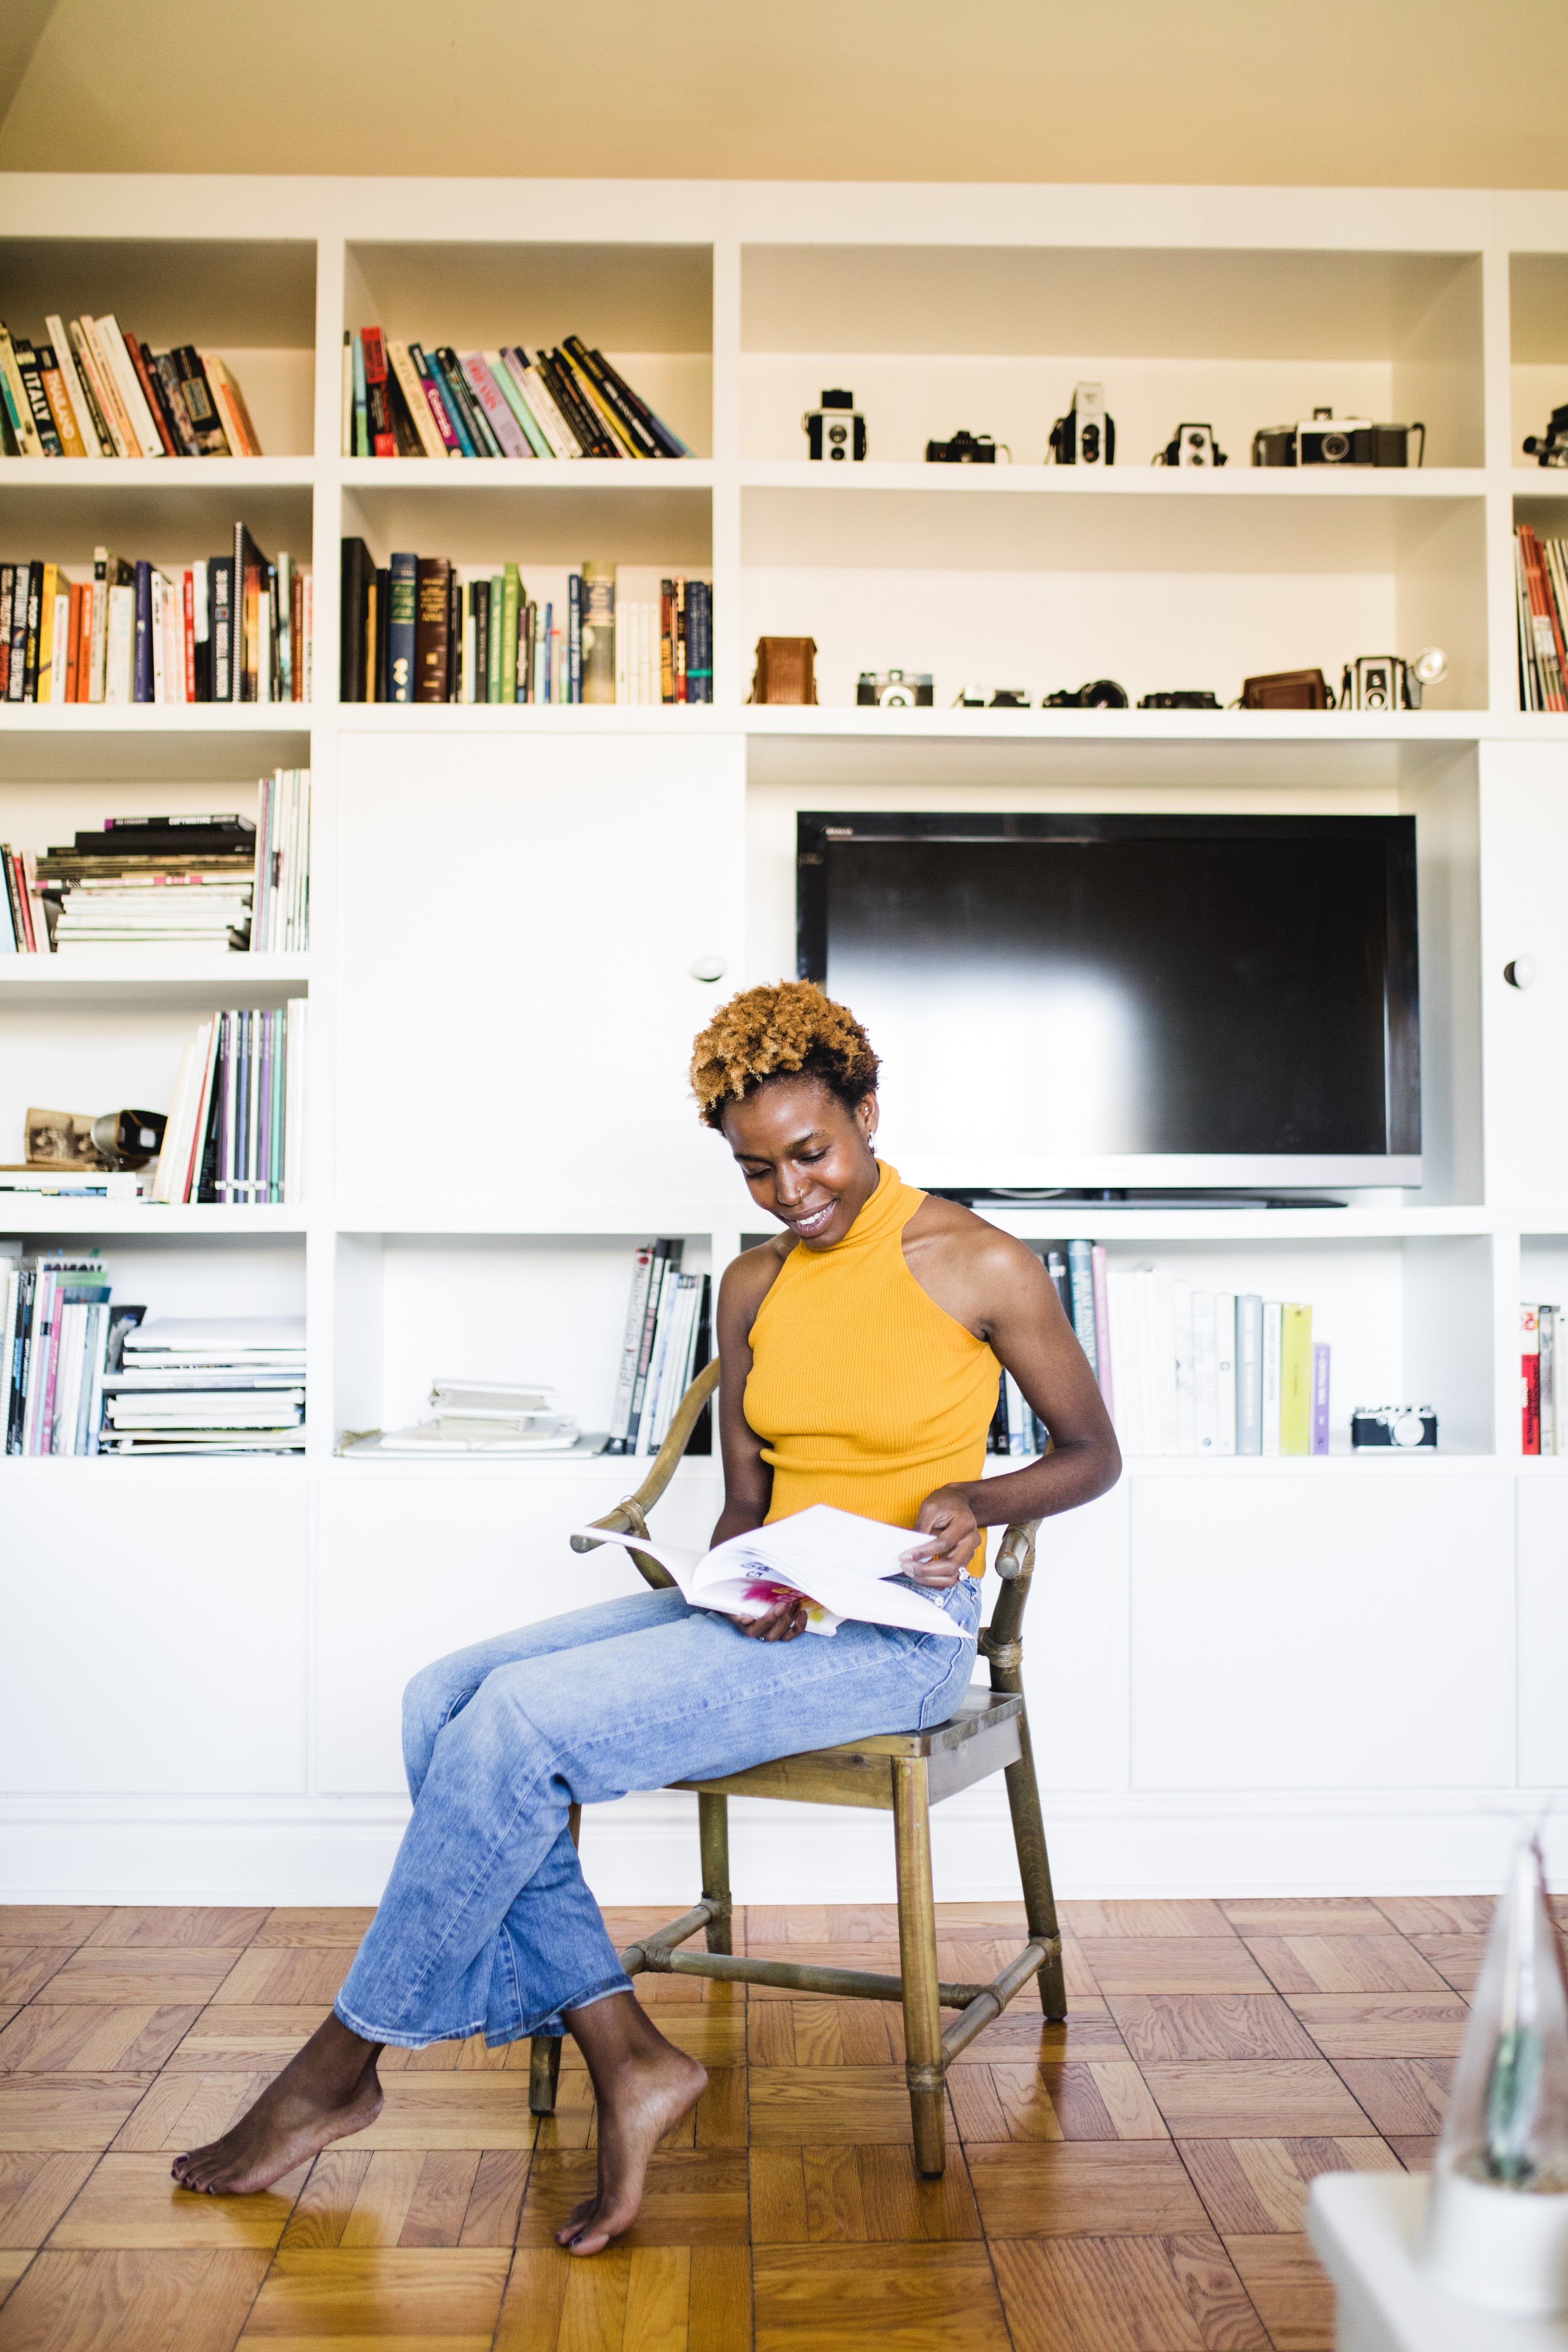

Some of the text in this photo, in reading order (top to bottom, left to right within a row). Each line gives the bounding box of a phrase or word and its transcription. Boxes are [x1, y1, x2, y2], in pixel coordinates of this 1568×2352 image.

[24, 372, 52, 421] ITALY
[45, 371, 76, 440] THAILAND
[427, 388, 452, 439] Colorado
[14, 567, 29, 628] OPPORTUNITY
[168, 817, 211, 826] COPYWRITING
[1080, 1270, 1097, 1368] GREAT PAINTINGS
[1318, 1359, 1327, 1387] CRYSTAL
